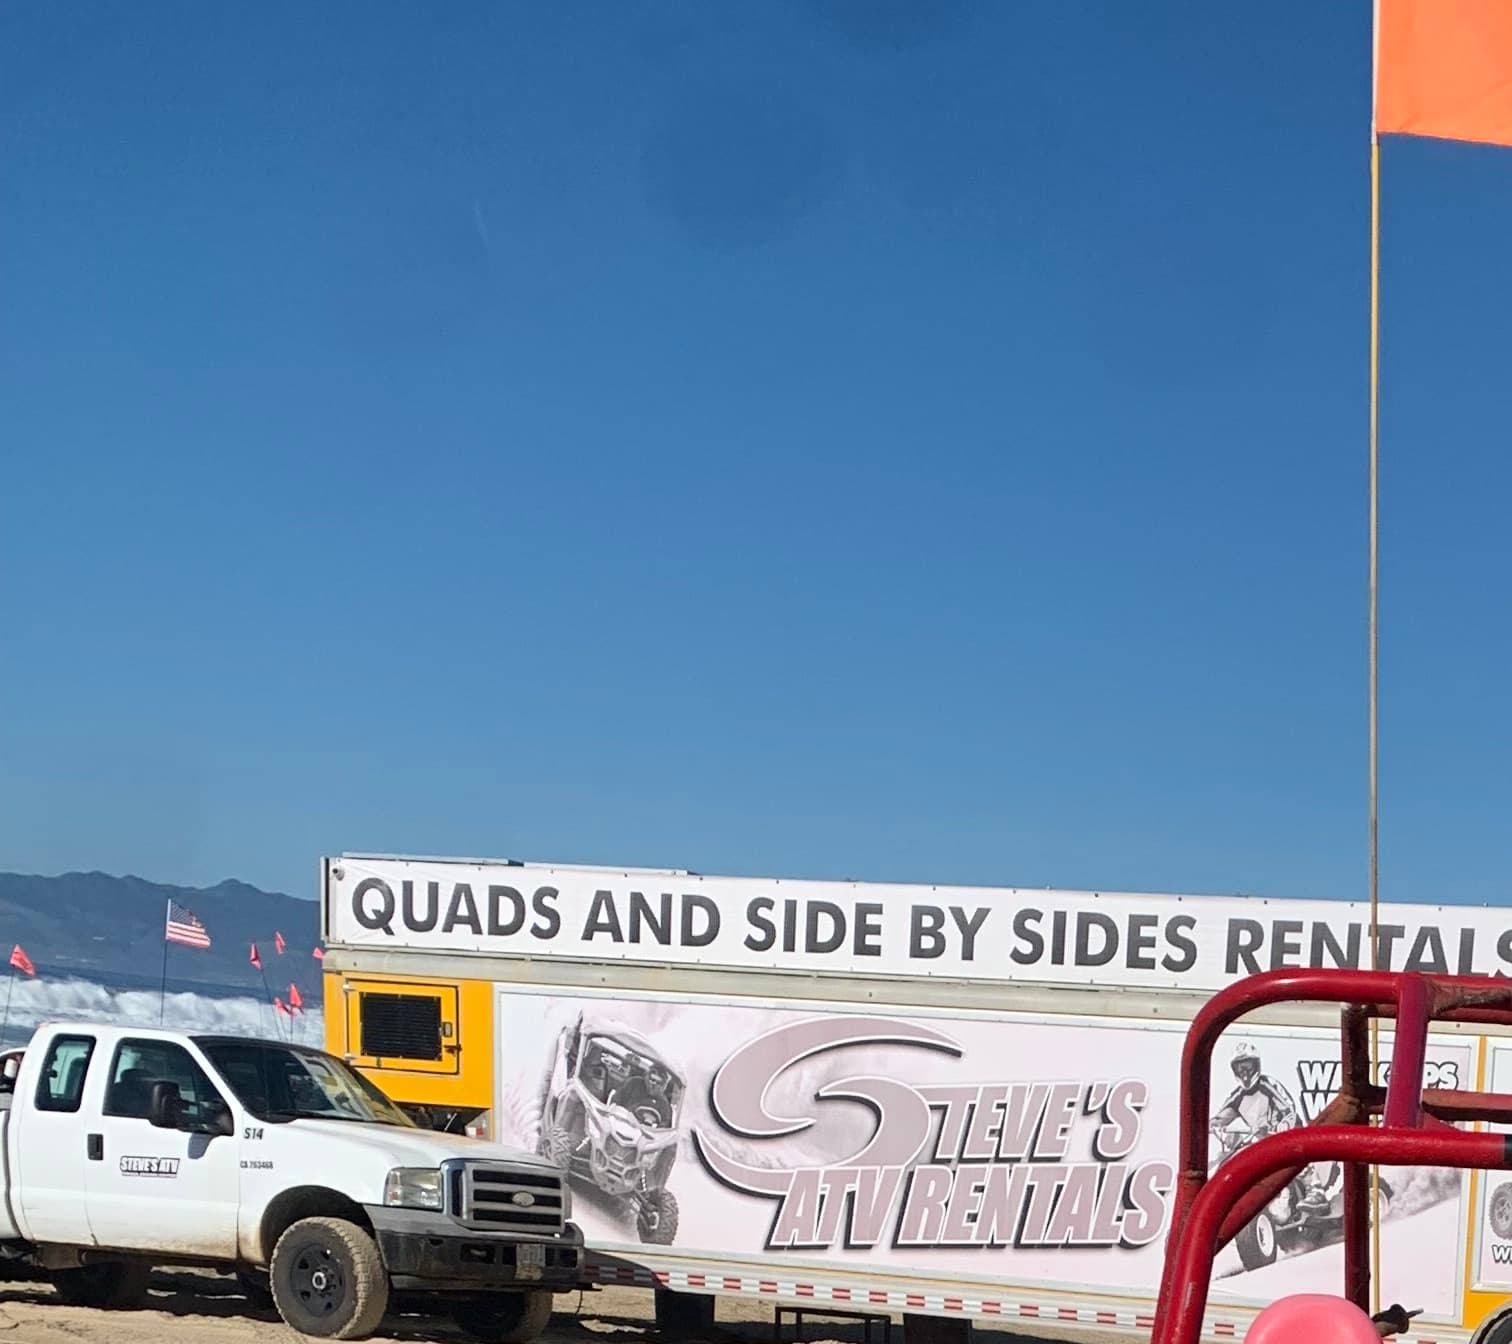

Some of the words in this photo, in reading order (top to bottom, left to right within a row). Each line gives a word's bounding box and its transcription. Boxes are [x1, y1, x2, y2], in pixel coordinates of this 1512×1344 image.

[351, 876, 562, 937] QUADS
[580, 889, 722, 949] AND
[742, 897, 882, 957] SIDE
[908, 906, 992, 962] BY
[1008, 908, 1199, 971] SIDES
[243, 1127, 264, 1140] S14
[766, 1165, 904, 1247] ATV
[893, 1161, 1174, 1248] RENTALS
